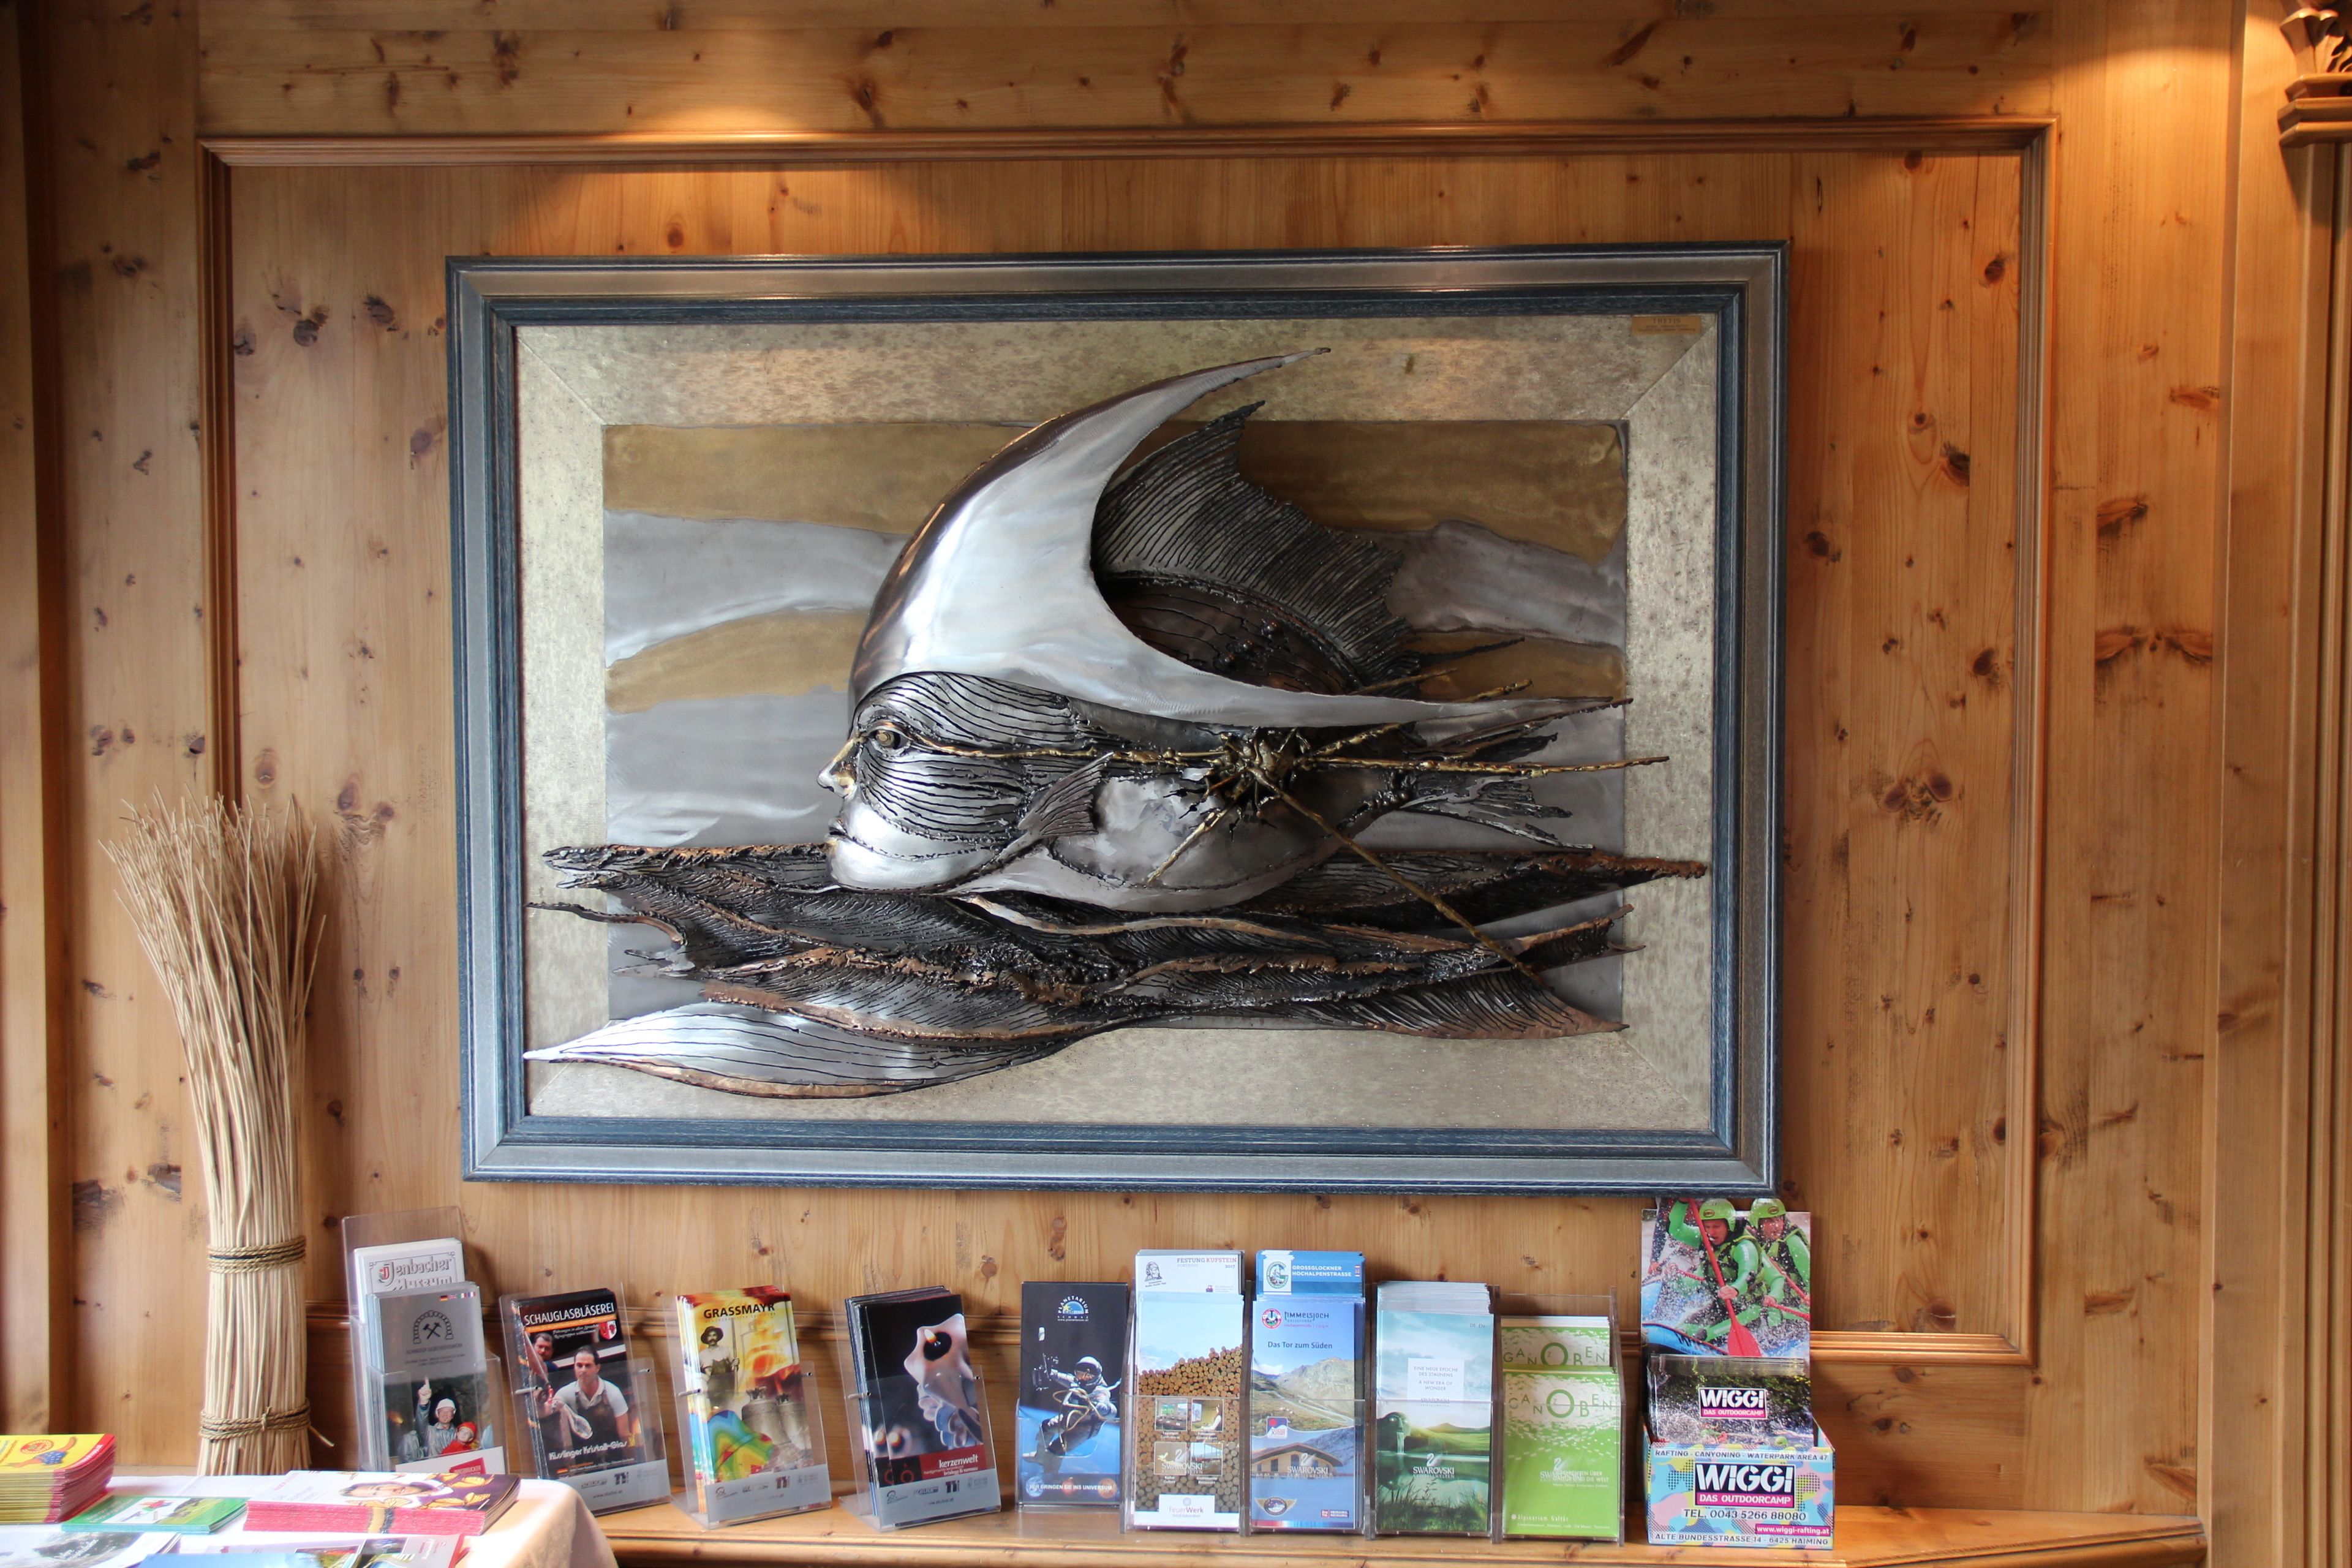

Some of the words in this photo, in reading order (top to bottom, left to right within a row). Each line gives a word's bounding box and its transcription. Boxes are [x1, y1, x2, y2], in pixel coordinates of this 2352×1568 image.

[703, 1303, 775, 1319] GRASSMAYR
[1058, 1295, 1089, 1314] PLANETARIUM
[524, 1302, 615, 1326] SCHAUGLASBLÄSEREI
[1700, 1389, 1765, 1408] WIGGI
[939, 1454, 979, 1469] kerzenwelt
[1287, 1466, 1329, 1474] SWAROVSKI
[1412, 1466, 1455, 1475] SWAROVSKI
[1696, 1464, 1794, 1493] WIGGI
[1721, 1495, 1792, 1504] OUTDOORCAMP
[1710, 1510, 1738, 1519] 0043
[1741, 1510, 1768, 1520] 5266
[1771, 1512, 1807, 1520] 88080
[1756, 1525, 1830, 1535] www.wiggi-rafting.at
